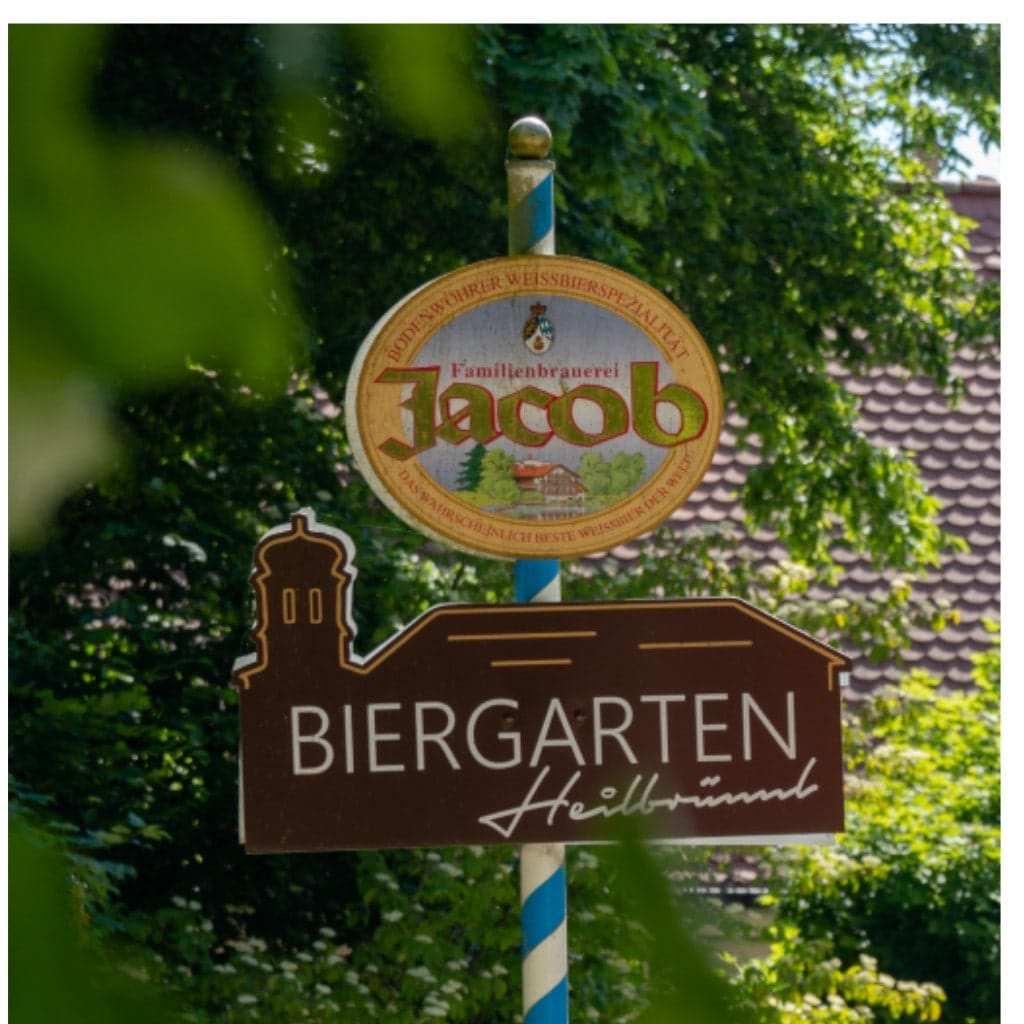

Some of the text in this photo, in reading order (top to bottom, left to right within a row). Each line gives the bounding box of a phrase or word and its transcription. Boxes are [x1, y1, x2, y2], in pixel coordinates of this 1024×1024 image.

[450, 362, 619, 379] Familienbrauerei
[374, 360, 710, 461] Jacob
[535, 531, 575, 543] BESTE
[578, 504, 646, 539] WEISSBIER
[644, 487, 668, 511] DER
[290, 691, 799, 776] BIERGARTEN
